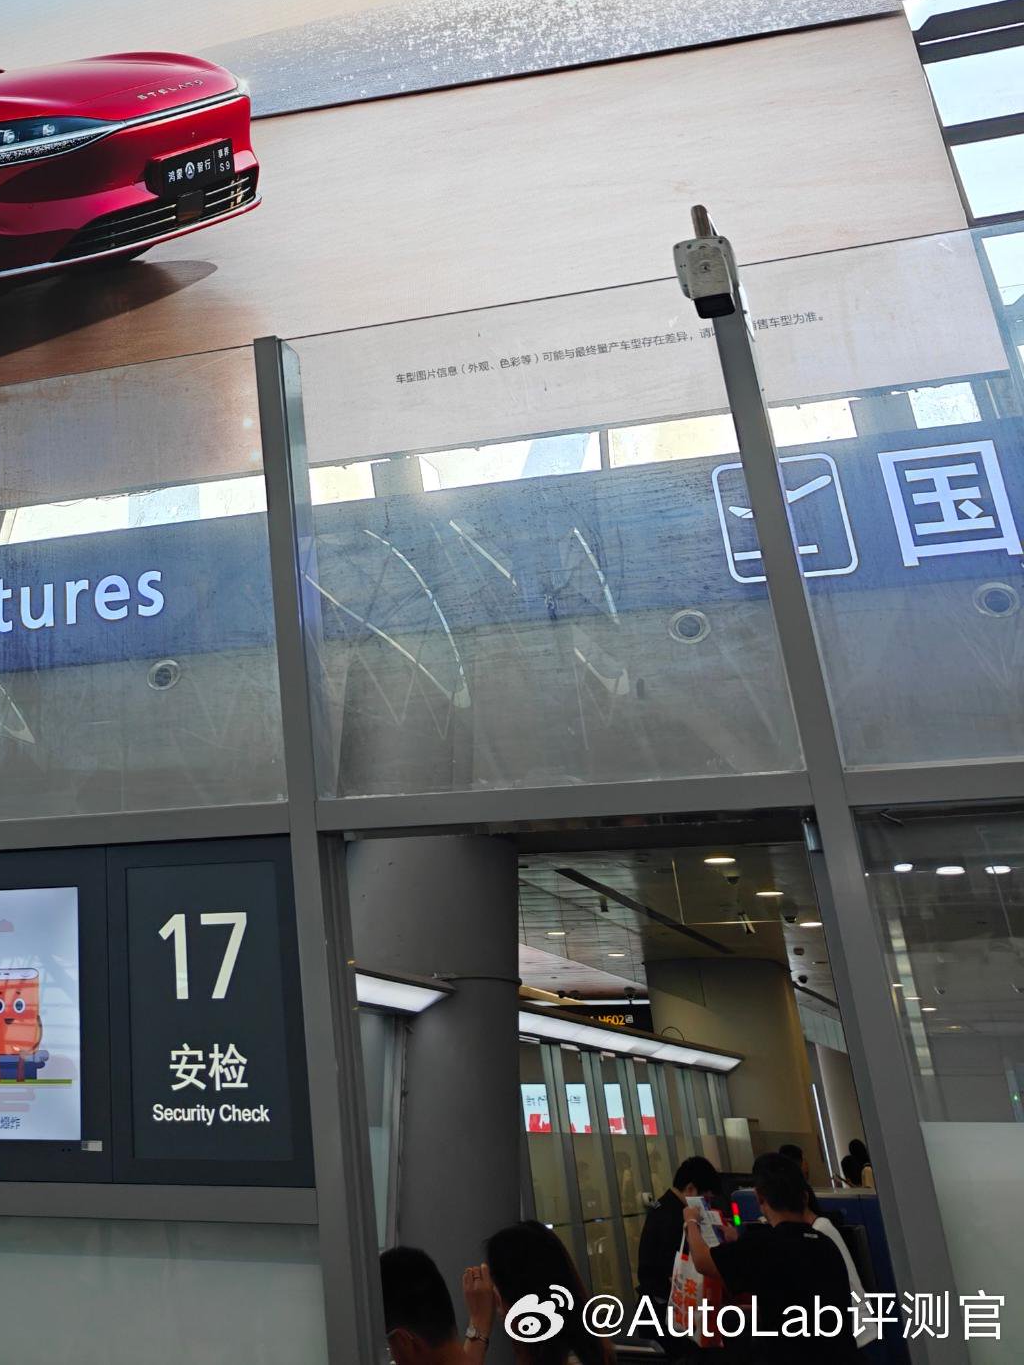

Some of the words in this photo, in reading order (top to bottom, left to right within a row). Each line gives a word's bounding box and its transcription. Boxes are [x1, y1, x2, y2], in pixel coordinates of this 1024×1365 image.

[158, 911, 247, 1000] 17
[169, 1042, 249, 1091] 安检
[152, 1103, 216, 1126] Security
[219, 1103, 271, 1122] Check
